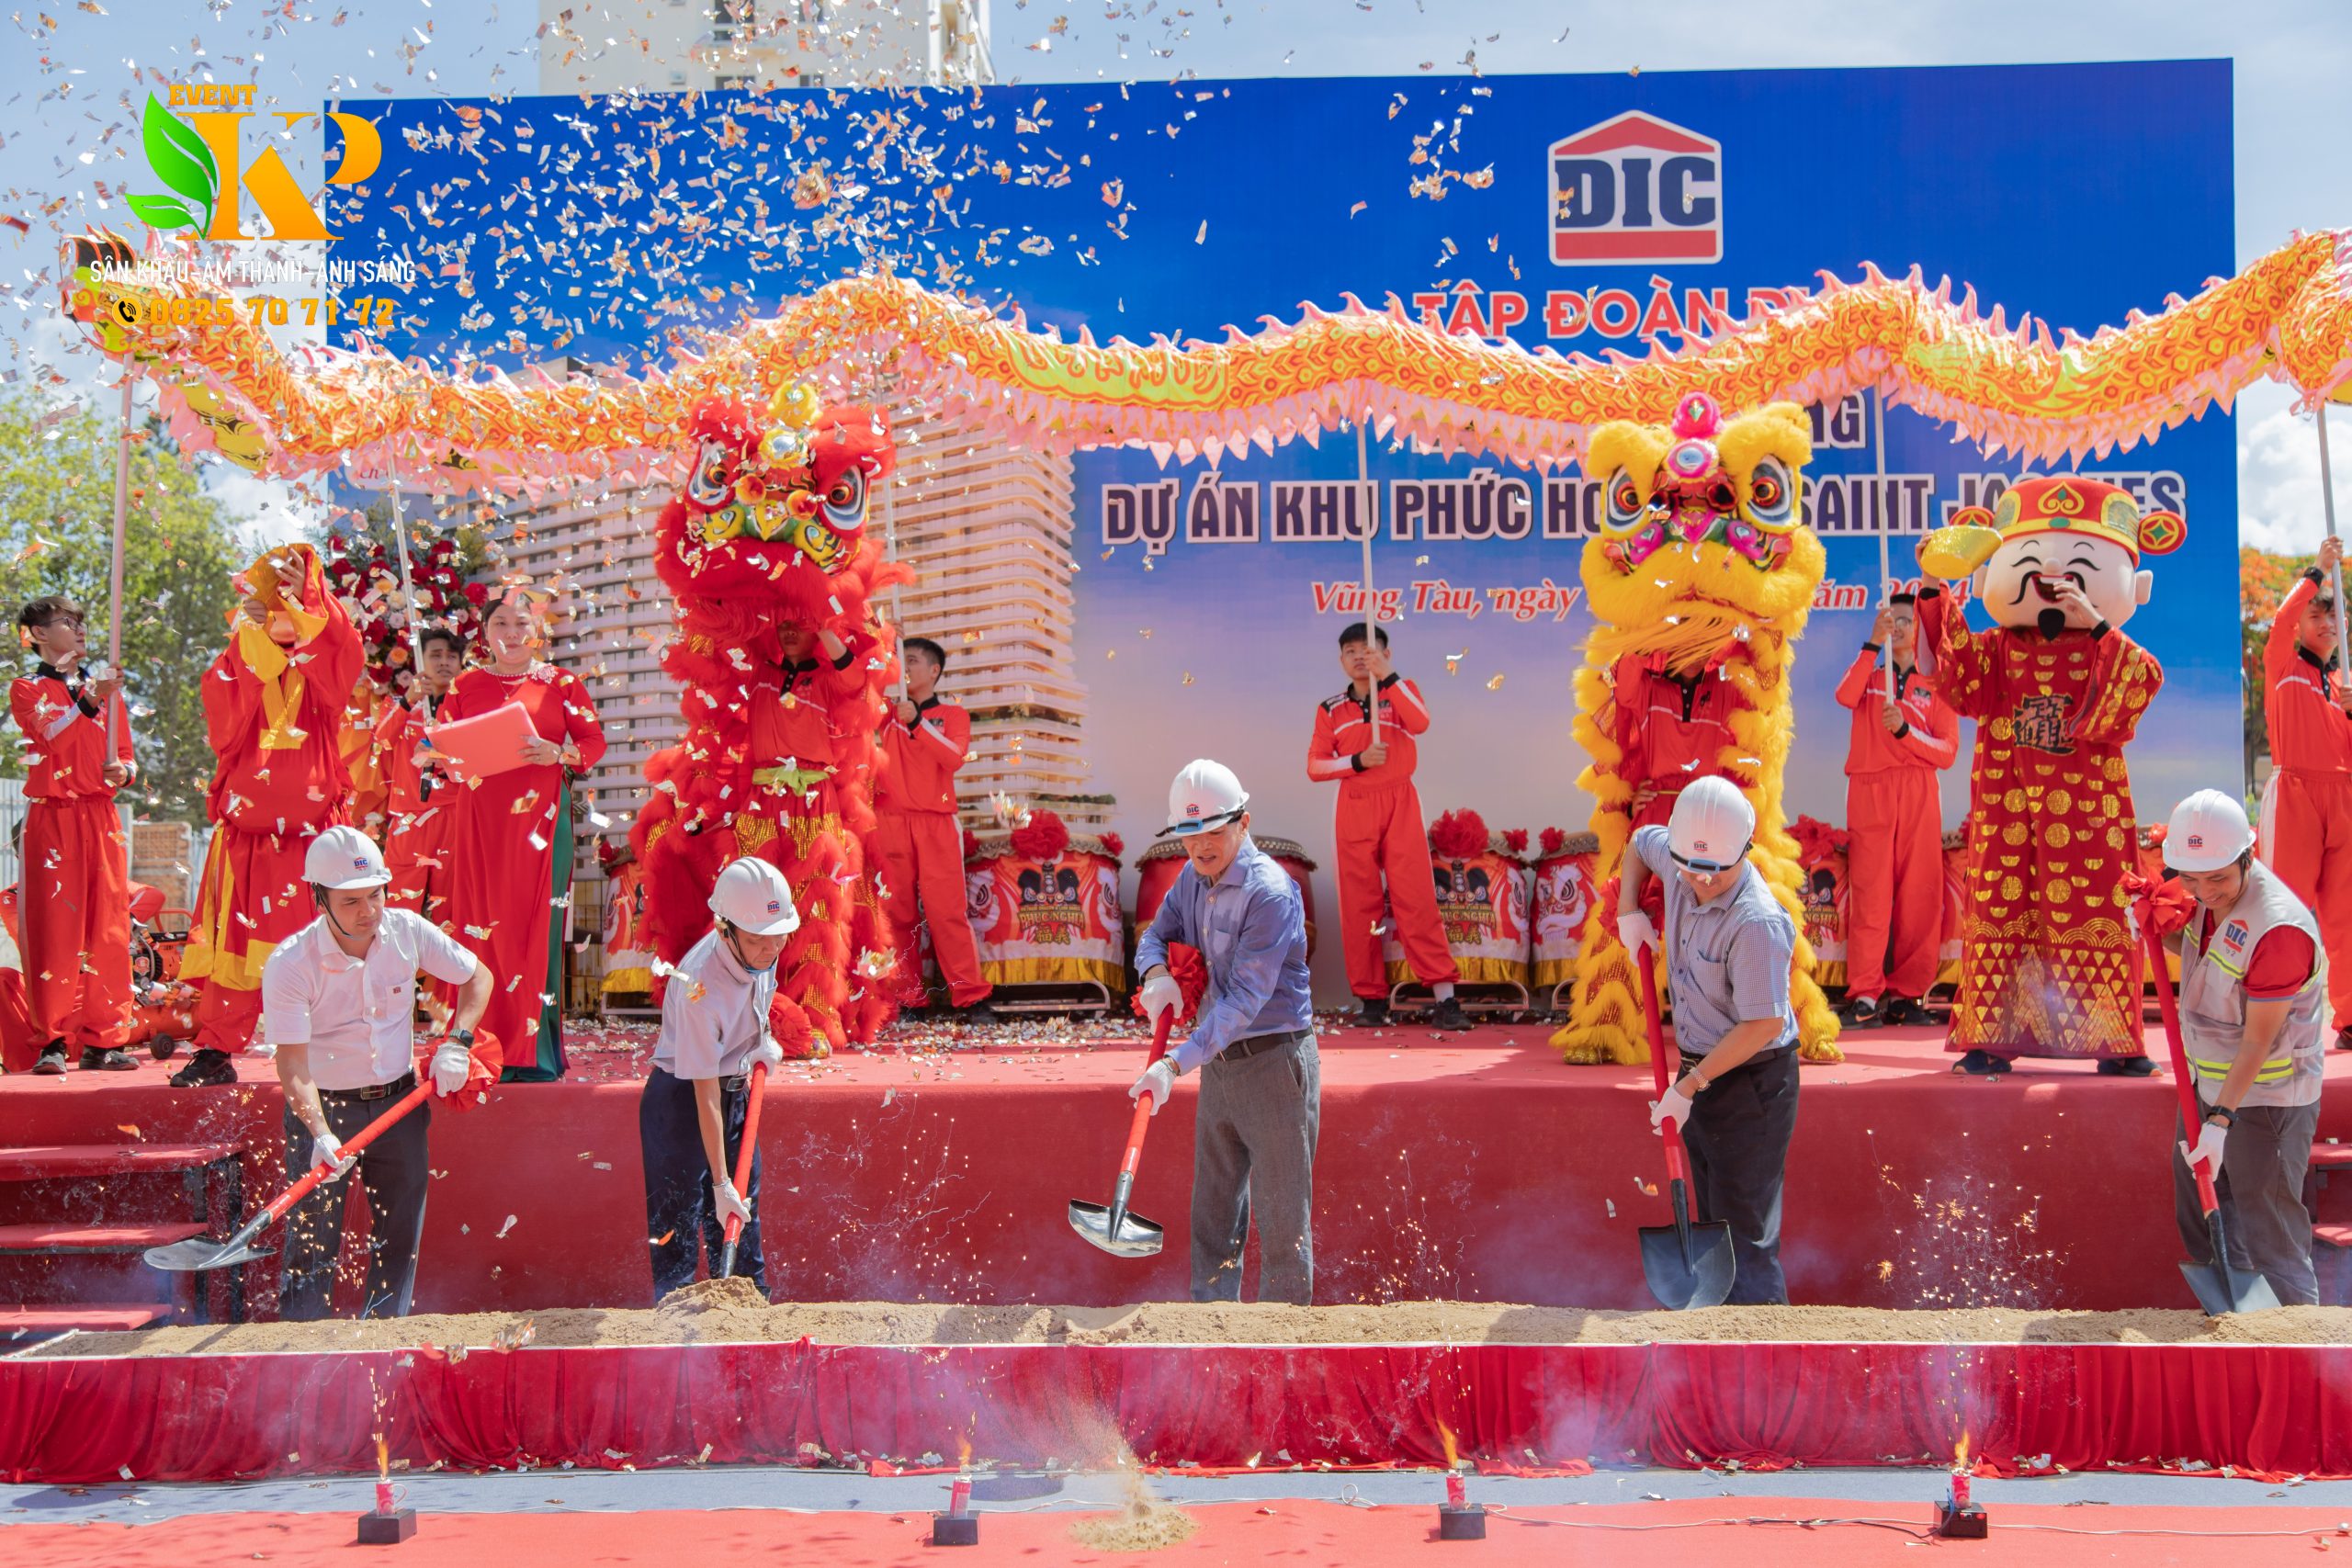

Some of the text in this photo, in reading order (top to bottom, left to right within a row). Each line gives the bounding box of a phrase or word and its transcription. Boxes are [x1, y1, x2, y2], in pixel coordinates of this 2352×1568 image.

[1555, 156, 1716, 228] DIC
[1544, 273, 1730, 339] ĐOÀN
[1102, 478, 1180, 555] DỰ
[1186, 471, 1260, 543] ÁN
[1271, 480, 1379, 542] KHU
[1390, 468, 1532, 541] PHỨC
[1312, 581, 1403, 623] Vũng
[1411, 579, 1484, 619] Tàu,
[1493, 577, 1582, 622] ngày
[1812, 578, 1869, 611] ăm
[2225, 922, 2248, 947] DIC
